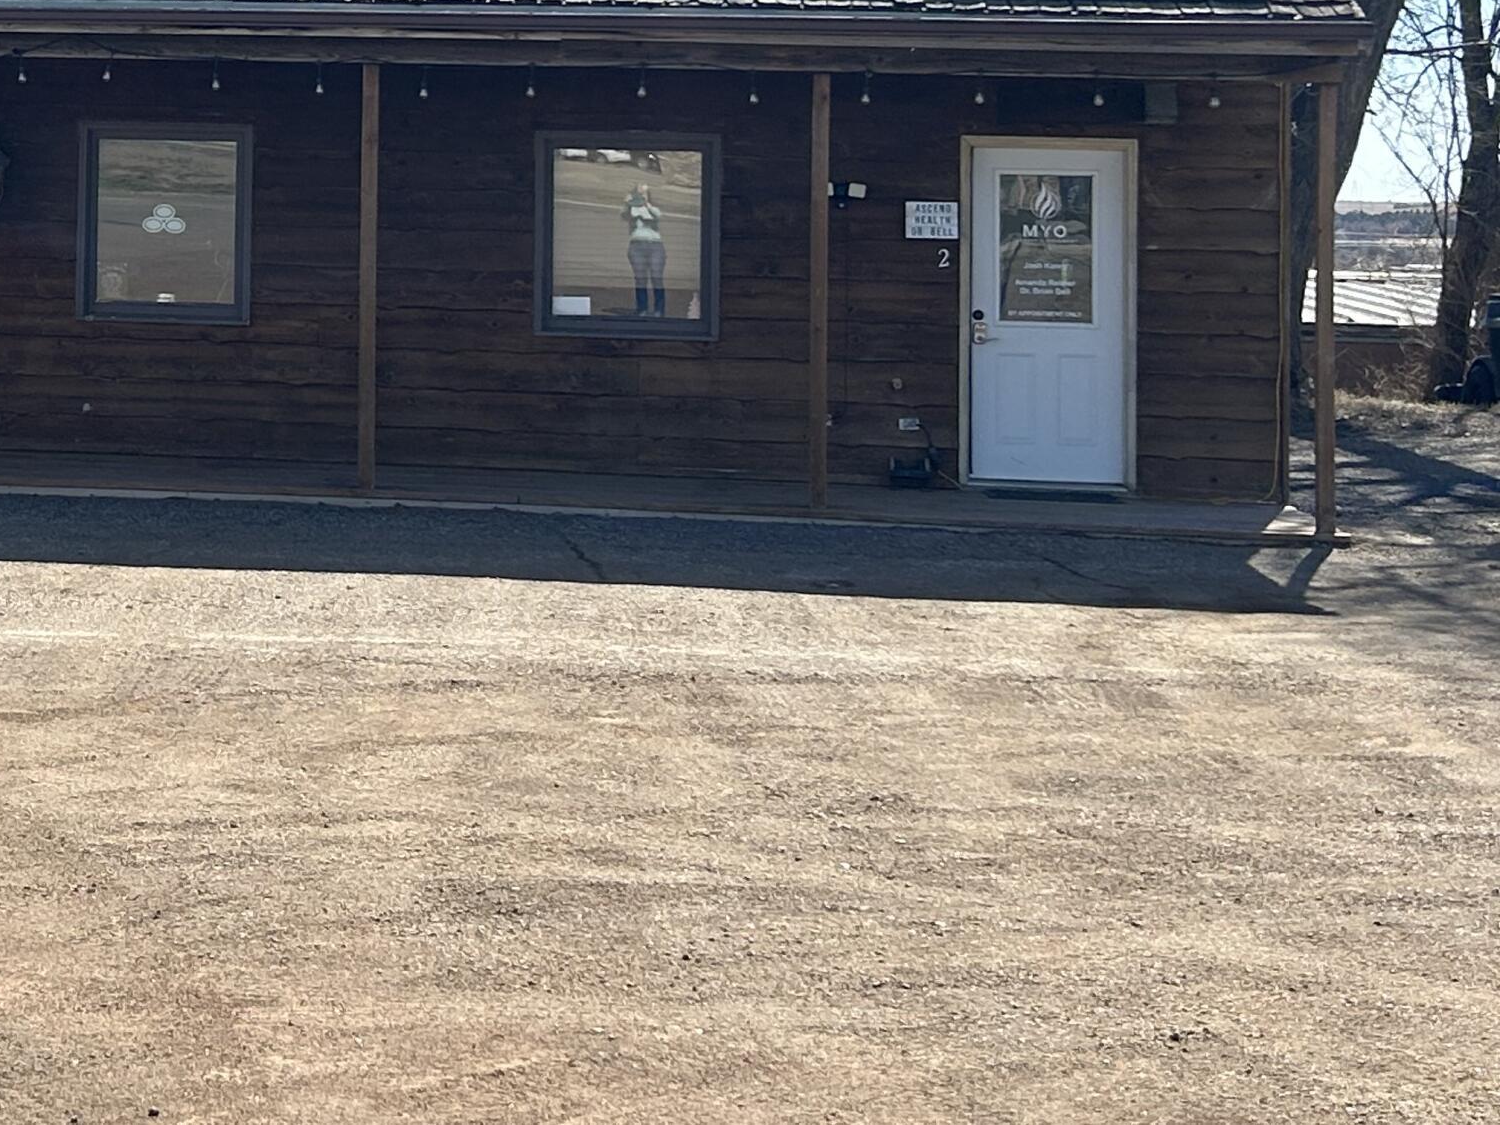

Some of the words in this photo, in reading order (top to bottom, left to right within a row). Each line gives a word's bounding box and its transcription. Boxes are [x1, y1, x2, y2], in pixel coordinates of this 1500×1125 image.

[915, 203, 952, 214] ASCEND
[914, 215, 951, 225] HEALTH
[930, 226, 954, 236] BELL
[1022, 224, 1067, 239] MYO
[937, 248, 950, 268] 2
